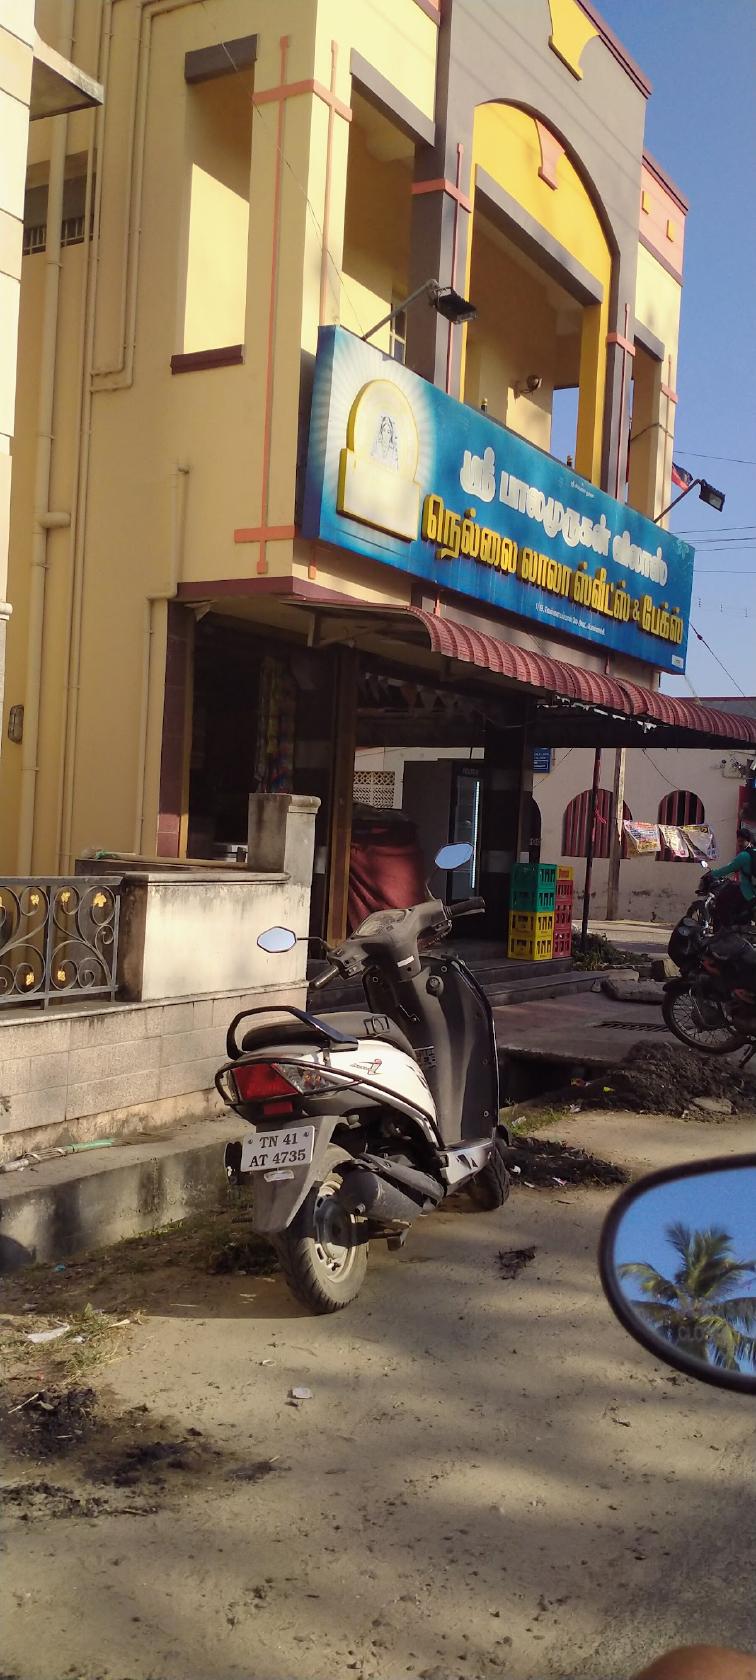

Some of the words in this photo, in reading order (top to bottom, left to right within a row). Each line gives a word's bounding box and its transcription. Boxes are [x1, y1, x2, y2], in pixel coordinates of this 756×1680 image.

[460, 447, 496, 503] ஸ்ரீ
[499, 470, 611, 557] பாலமுருகன்
[612, 530, 668, 587] விலாஸ்
[423, 493, 518, 575] நெல்லை
[519, 547, 572, 597] லாலா
[573, 561, 631, 623] ஸ்வீட்ஸ்
[632, 599, 640, 621] &
[641, 595, 684, 645] பேக்ஸ்
[249, 1153, 268, 1167] AT
[272, 1148, 306, 1164] 4735
[259, 1135, 279, 1149] TN
[282, 1132, 298, 1145] 41
